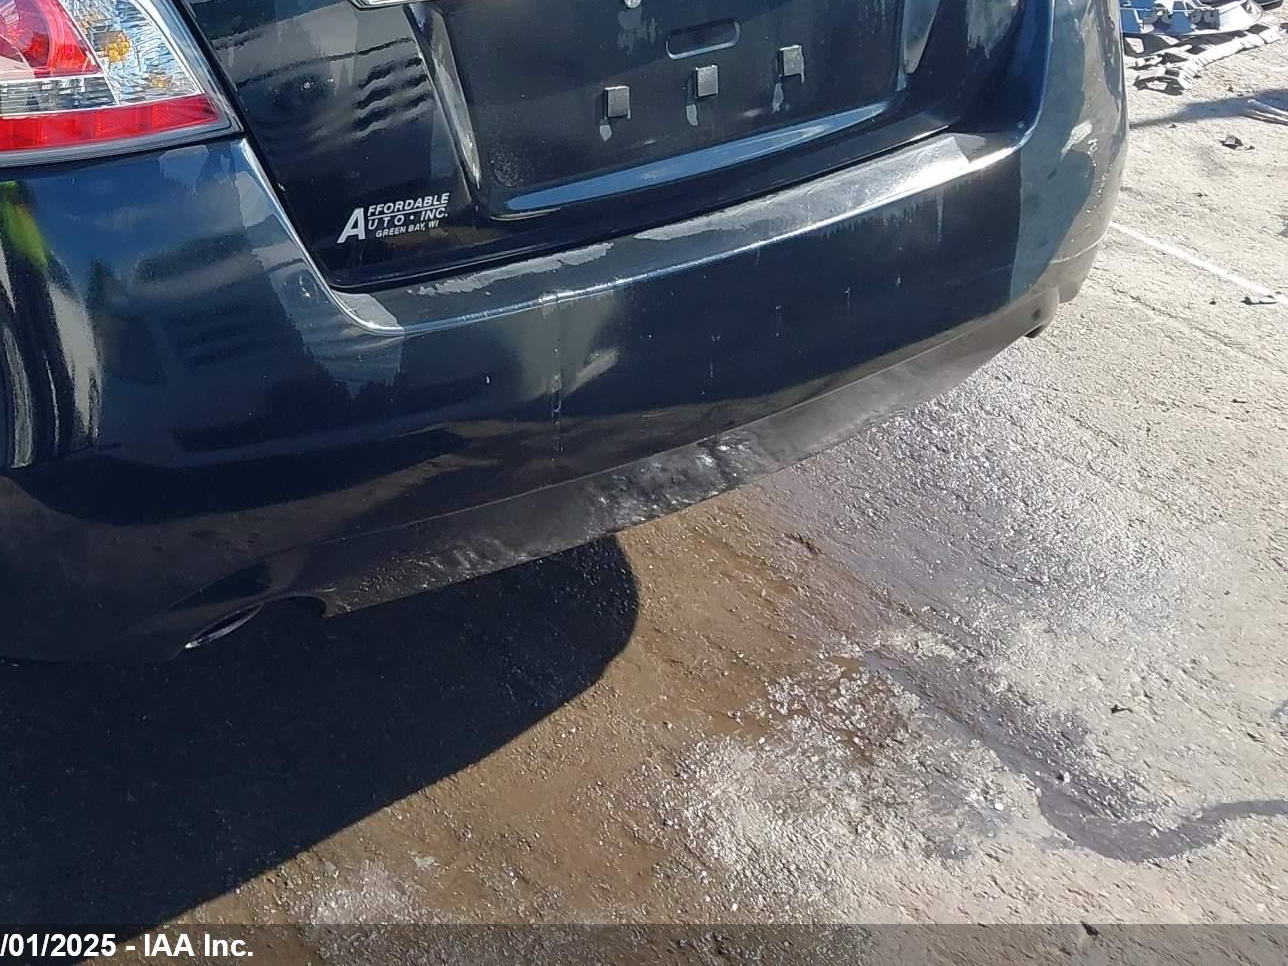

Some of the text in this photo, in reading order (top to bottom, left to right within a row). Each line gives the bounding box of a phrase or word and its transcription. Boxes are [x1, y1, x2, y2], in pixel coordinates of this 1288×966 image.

[420, 207, 448, 221] INC.
[375, 219, 440, 238] GREEN BAY, WI
